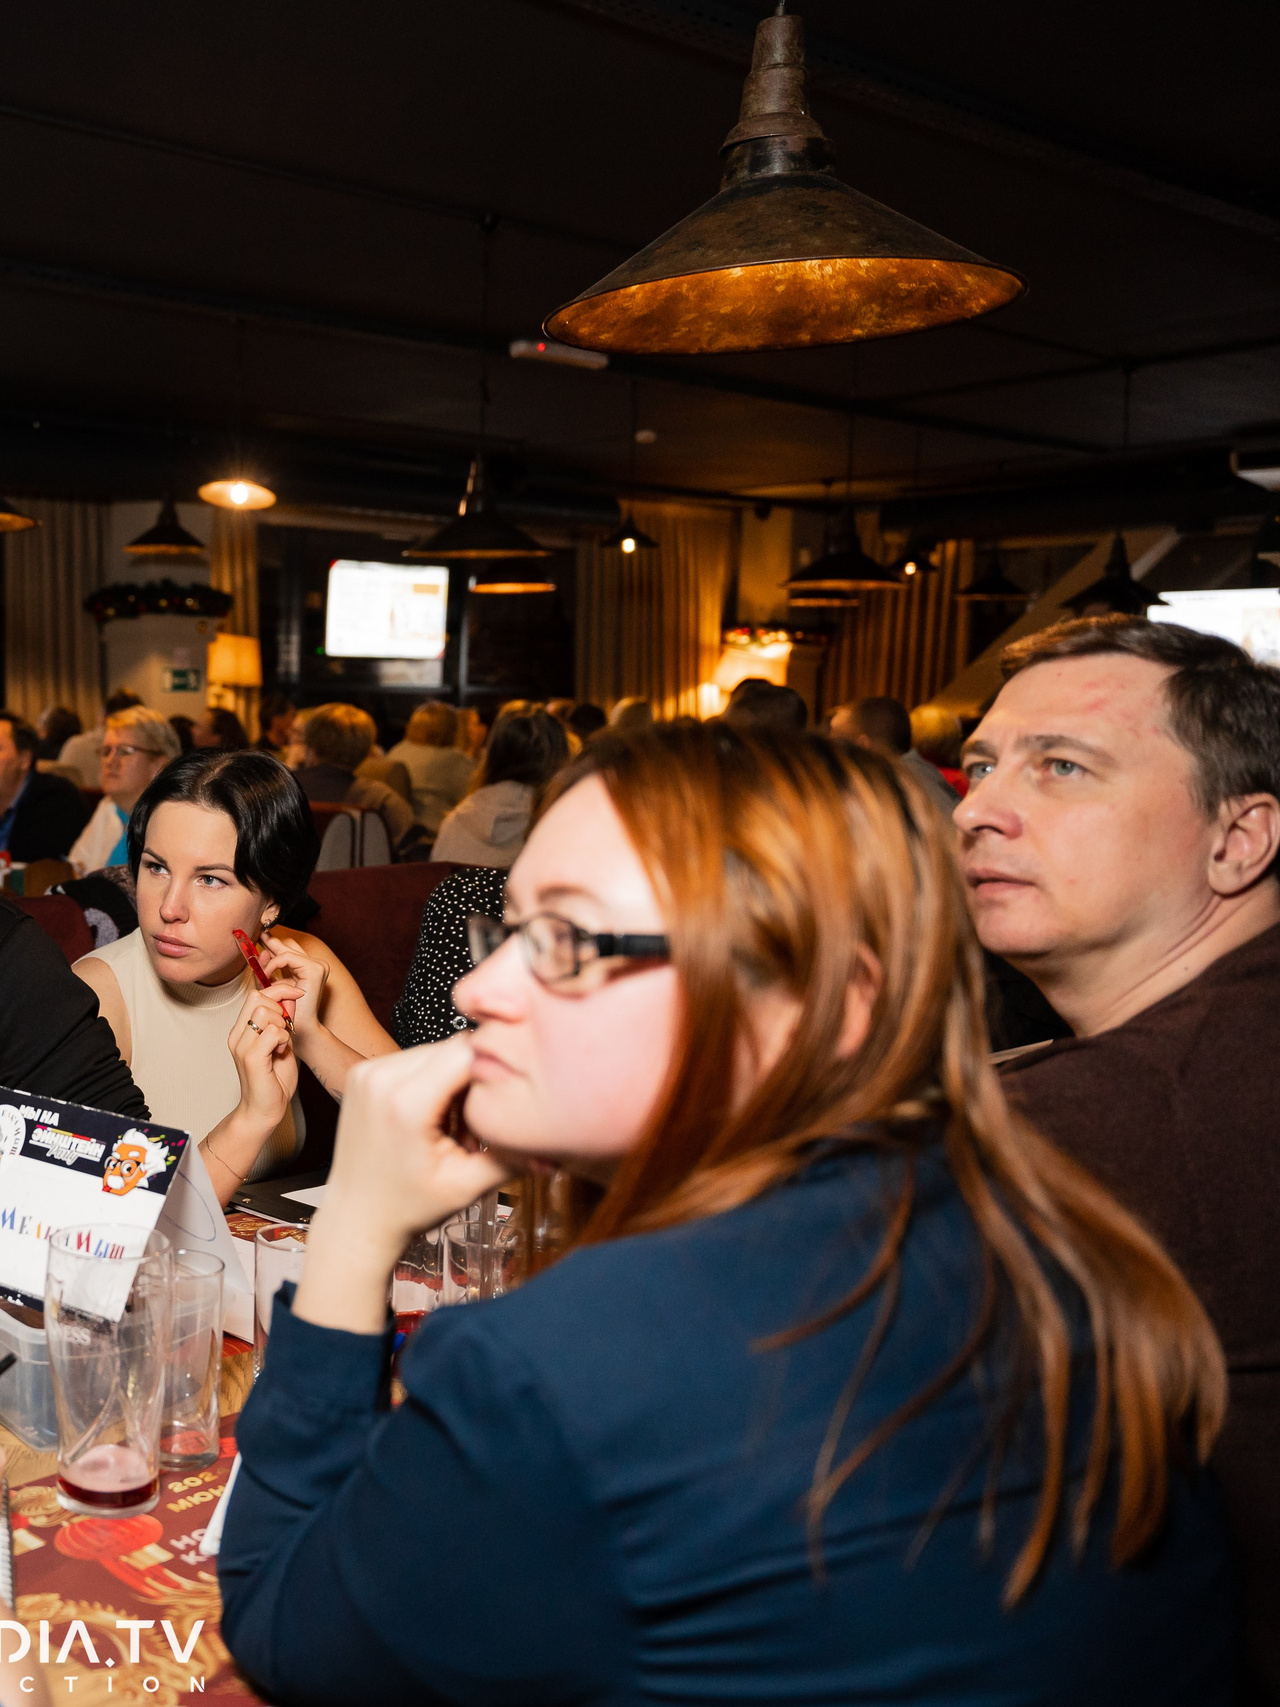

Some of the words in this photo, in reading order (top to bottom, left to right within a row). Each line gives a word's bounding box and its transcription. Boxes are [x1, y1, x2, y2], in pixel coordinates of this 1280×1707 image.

[38, 1109, 61, 1127] НА
[30, 1127, 107, 1159] ЭЙНШТЕЙН
[45, 1144, 79, 1167] Party
[167, 1470, 229, 1494] 202
[166, 1485, 225, 1513] МЮН
